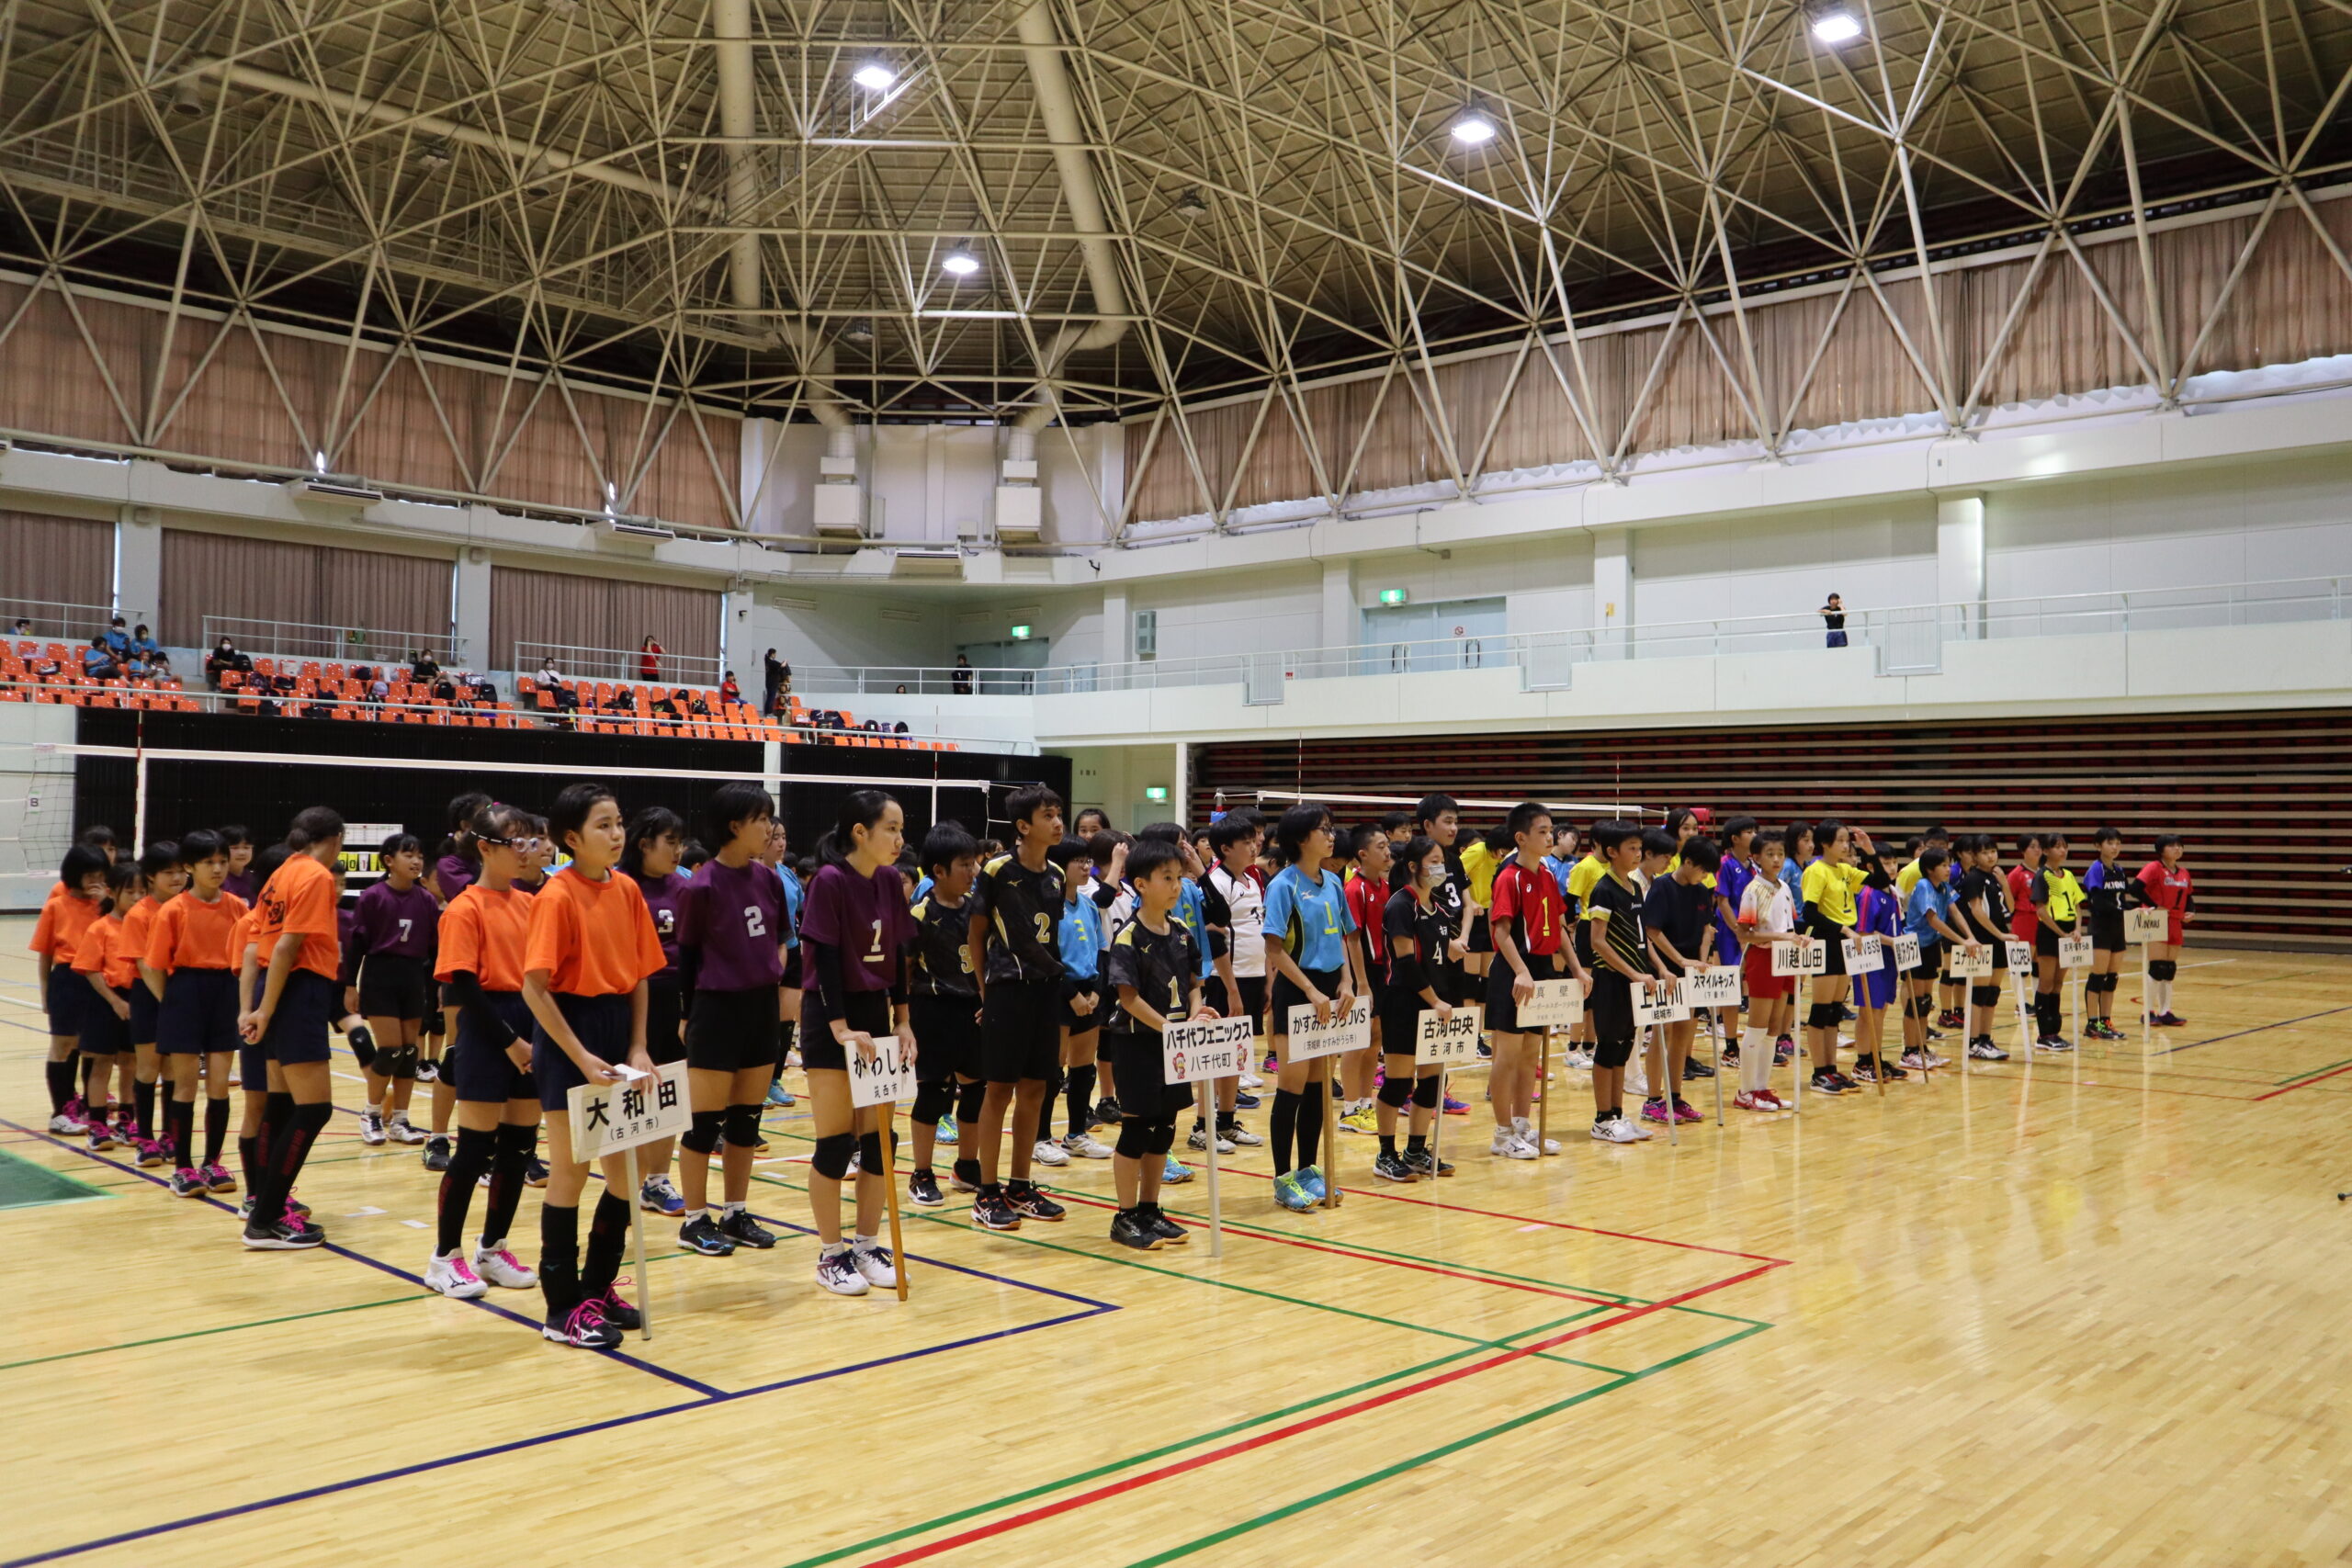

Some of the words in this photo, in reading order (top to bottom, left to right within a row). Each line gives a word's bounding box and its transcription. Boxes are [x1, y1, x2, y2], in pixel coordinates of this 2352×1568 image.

[30, 797, 39, 807] B
[1445, 882, 1461, 908] 3
[658, 909, 674, 933] 3
[743, 905, 766, 938] 2
[1324, 901, 1333, 926] 1
[1542, 897, 1550, 931] 1
[399, 919, 413, 942] 7
[871, 919, 882, 953] 1
[1035, 912, 1050, 943] 2
[1636, 914, 1645, 942] 1
[958, 944, 975, 974] 3
[1432, 941, 1442, 964] 4
[1778, 948, 1823, 969] 川越山田
[1168, 976, 1182, 1009] 1
[1536, 985, 1568, 998] 真壁
[1694, 973, 1736, 989] スマイルキッズ
[1640, 982, 1683, 1010] 上山川
[1167, 1021, 1251, 1051] 八千代フェニックス
[1424, 1015, 1474, 1040] 古河中央
[1430, 1041, 1465, 1056] 古河市
[1191, 1053, 1231, 1072] 八千代町
[874, 1082, 898, 1099] 筑西市
[586, 1079, 677, 1132] 大和田
[610, 1116, 660, 1141] (古河市)
